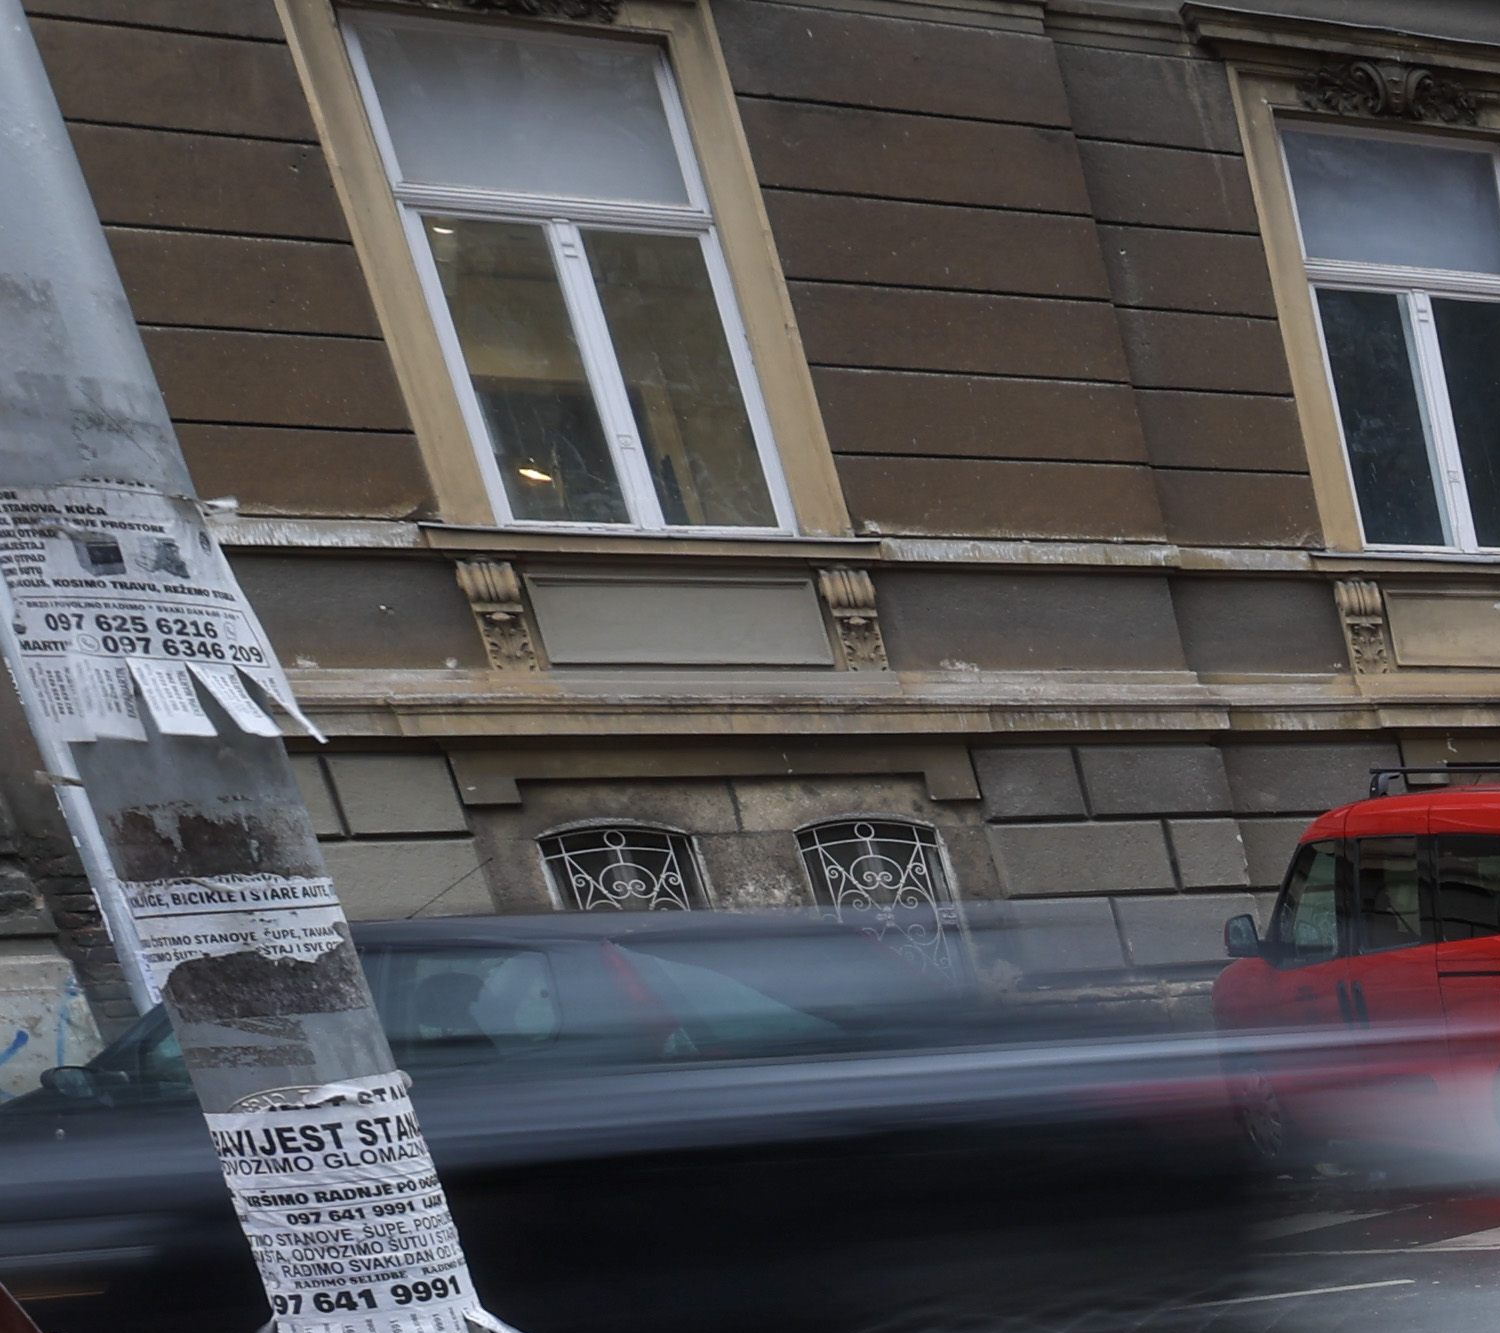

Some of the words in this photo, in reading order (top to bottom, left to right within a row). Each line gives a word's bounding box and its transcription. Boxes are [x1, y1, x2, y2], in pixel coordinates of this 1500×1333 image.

[64, 501, 107, 516] KUČA
[101, 520, 165, 534] PROSTORE
[53, 578, 107, 590] KOSIMO
[112, 580, 161, 594] TRAVU,
[164, 582, 210, 598] REŽEMO
[44, 613, 85, 632] 097
[96, 614, 148, 635] 625
[156, 617, 218, 640] 6216
[102, 635, 151, 655] 097
[163, 638, 225, 660] 6346
[228, 643, 265, 663] 209
[172, 890, 236, 907] BICIKLE
[250, 885, 300, 902] STARE
[195, 931, 258, 945] STANOVE
[313, 1182, 393, 1204] RADNJE
[397, 1178, 418, 1193] PO
[285, 1210, 323, 1226] 097
[328, 1205, 366, 1223] 641
[373, 1200, 417, 1217] 9991
[361, 1217, 413, 1242] ŠUPE,
[292, 1239, 385, 1264] ODVOZIMO
[388, 1231, 430, 1253] ŠUTU
[280, 1259, 346, 1280] RADIMO
[349, 1252, 399, 1274] SVAKI
[401, 1249, 436, 1268] DAN
[293, 1276, 347, 1290] RADIMO
[348, 1269, 408, 1286] SELIDBE
[270, 1292, 304, 1316] 97
[312, 1287, 378, 1313] 641
[389, 1274, 463, 1306] 9991
